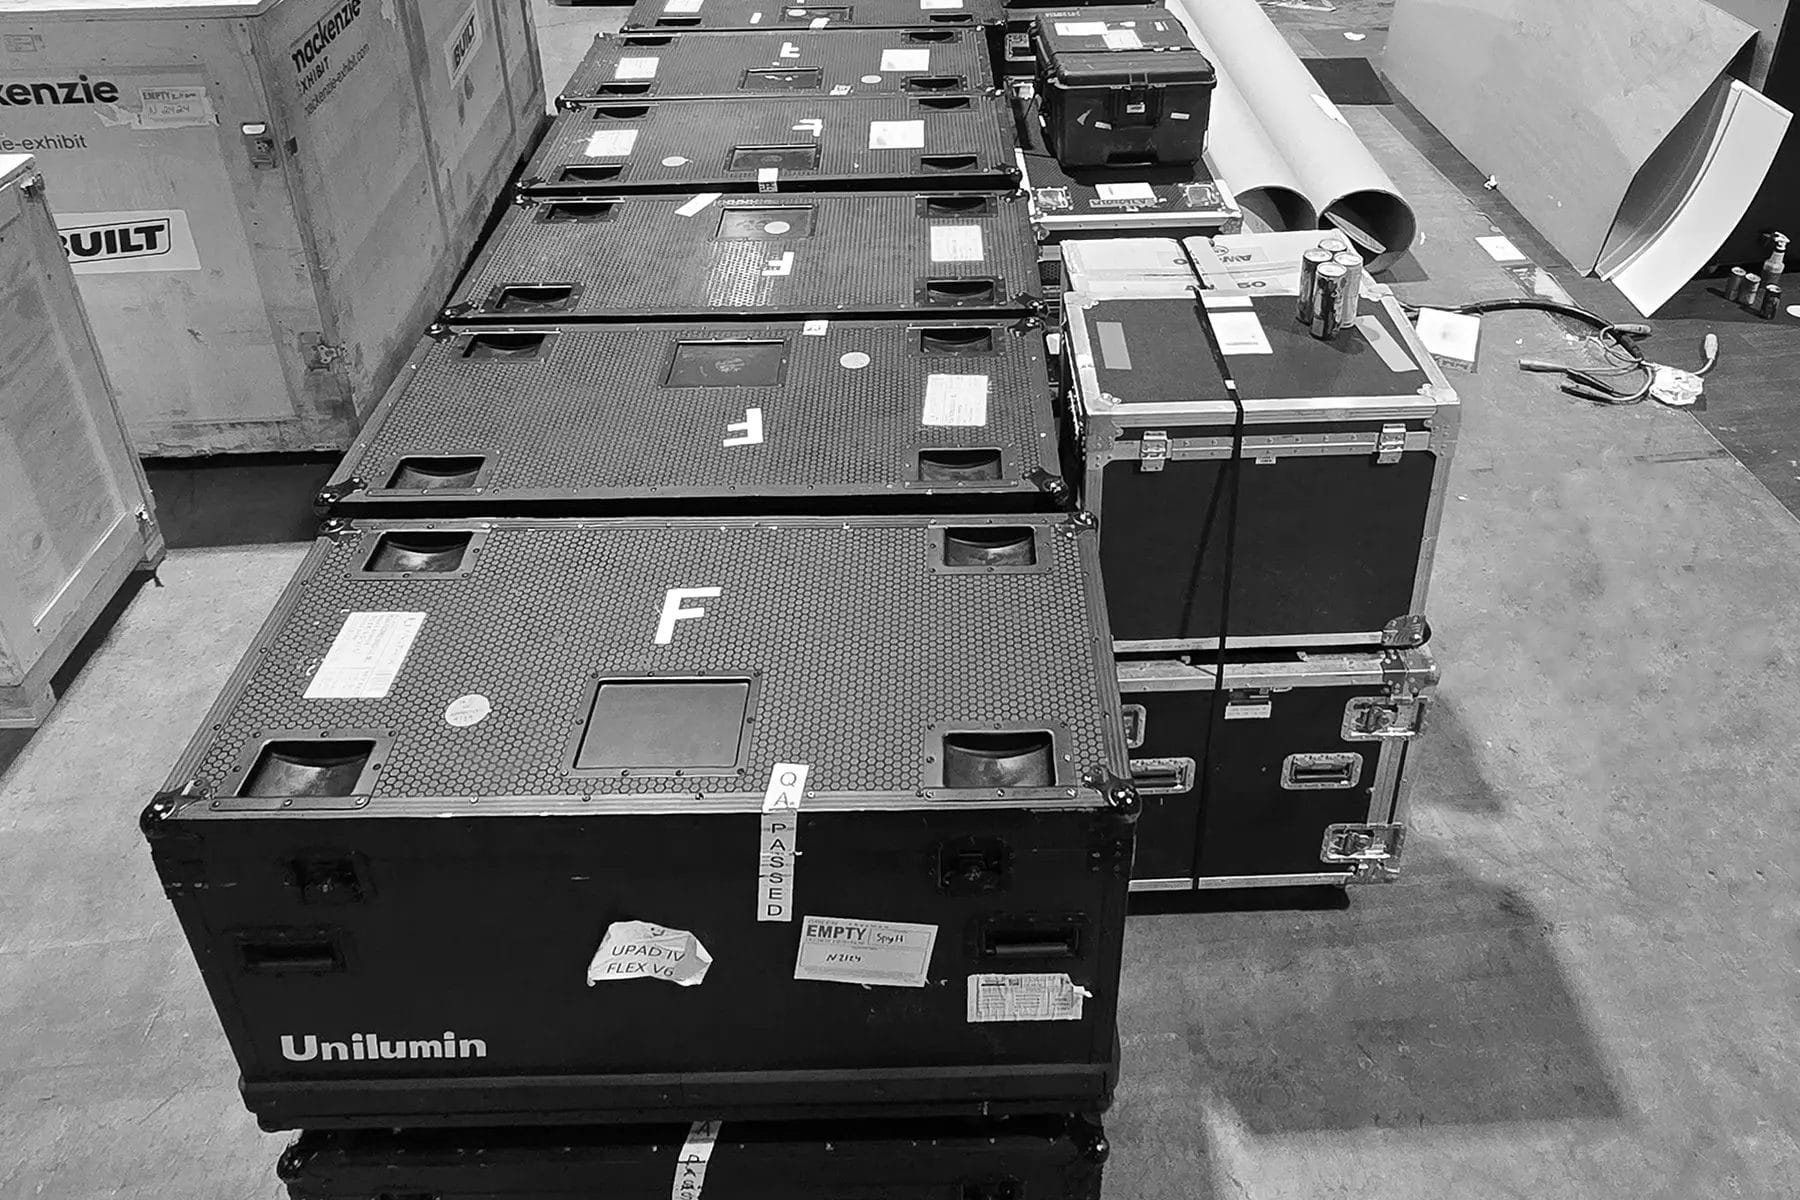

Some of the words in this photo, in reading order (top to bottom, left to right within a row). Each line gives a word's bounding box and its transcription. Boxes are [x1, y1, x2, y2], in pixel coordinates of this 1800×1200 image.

[453, 14, 475, 68] BUILT
[723, 407, 764, 447] F
[654, 586, 722, 645] F
[767, 823, 787, 917] PASSED
[806, 924, 867, 941] EMPTY
[606, 962, 648, 974] FLEX
[612, 944, 663, 958] UPAD
[280, 1031, 487, 1061] Unilumin
